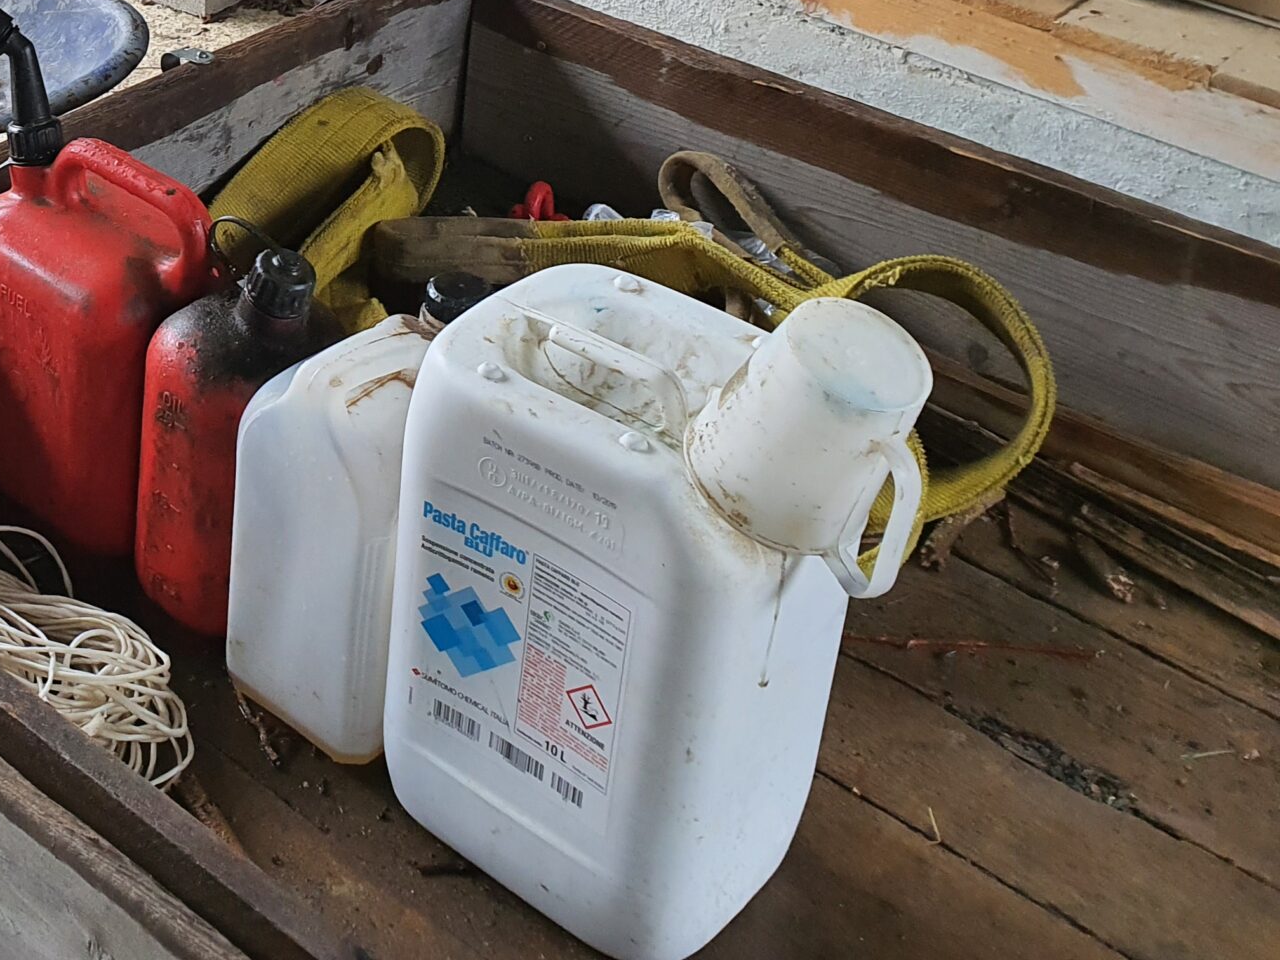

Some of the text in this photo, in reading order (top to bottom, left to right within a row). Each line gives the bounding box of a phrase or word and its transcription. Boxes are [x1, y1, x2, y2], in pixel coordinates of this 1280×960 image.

[0, 283, 31, 318] FUEL
[423, 501, 526, 565] Pasta Caffaro
[464, 536, 493, 558] BLU
[565, 719, 606, 751] ATTENZIONE
[545, 740, 567, 763] 10 L
